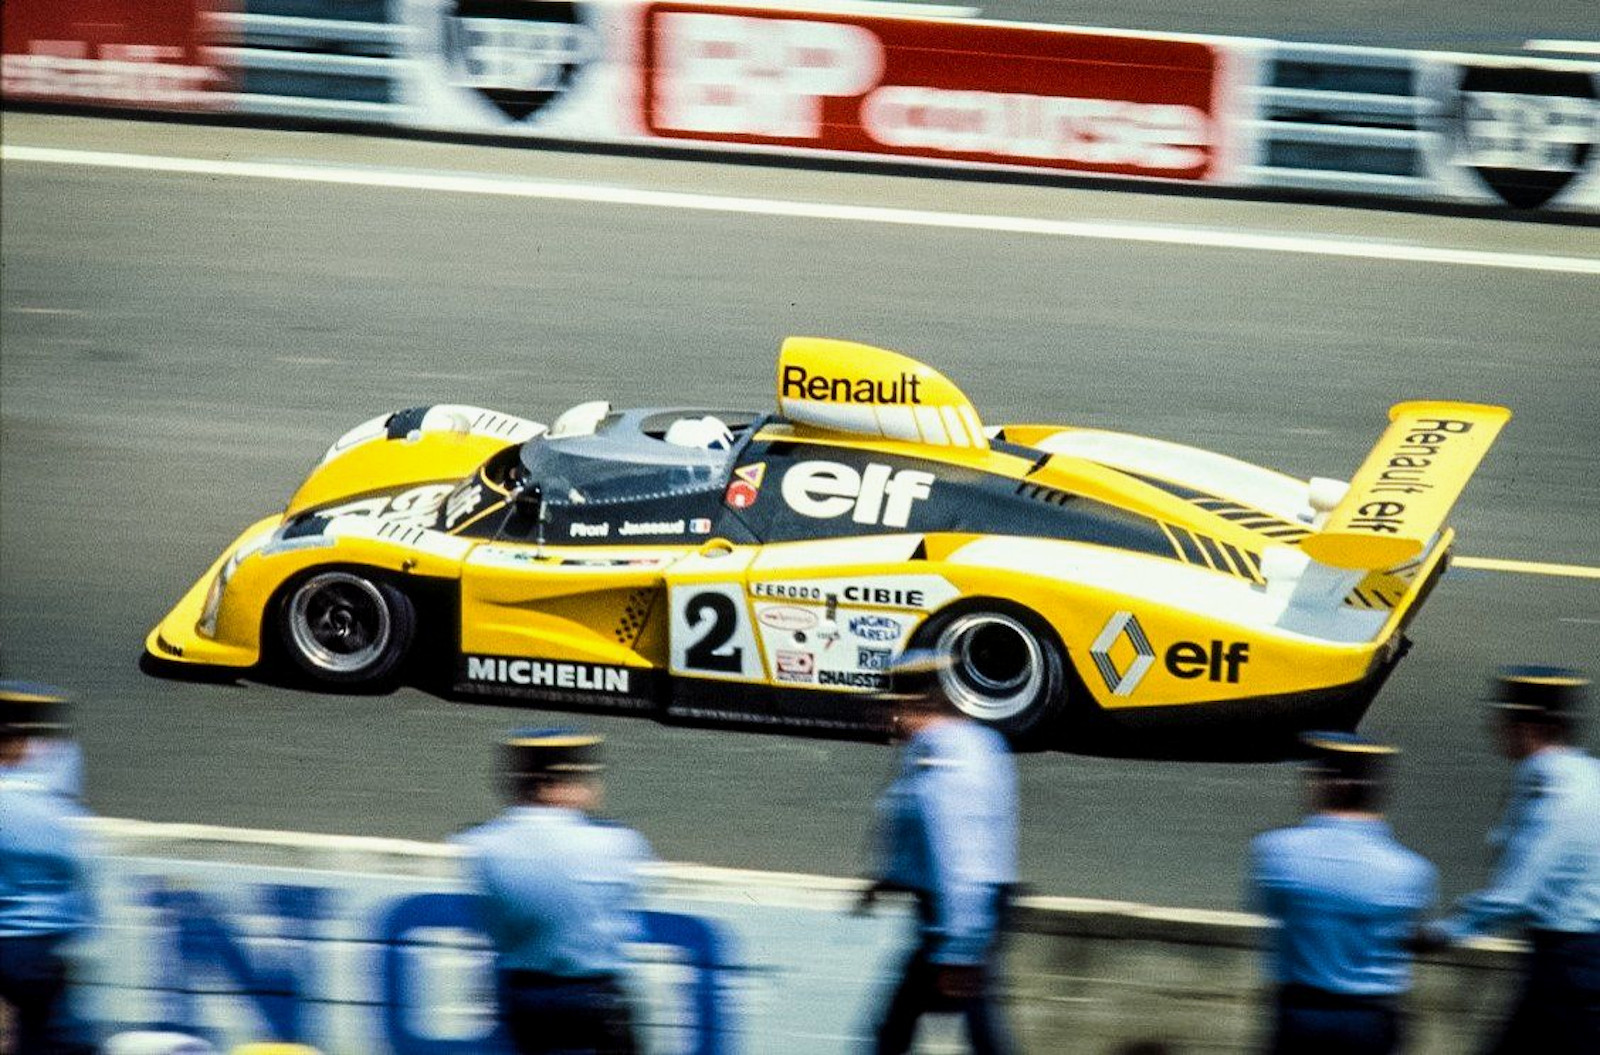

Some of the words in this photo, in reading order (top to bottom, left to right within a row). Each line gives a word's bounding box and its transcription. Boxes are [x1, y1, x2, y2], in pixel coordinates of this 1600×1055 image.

[783, 366, 921, 405] Renault
[1370, 419, 1474, 494] Renault
[781, 460, 935, 528] elf
[1347, 501, 1405, 533] elf
[756, 584, 821, 599] FERODO
[685, 591, 741, 670] 2
[467, 656, 630, 693] MICHELIN
[1165, 640, 1249, 684] elf
